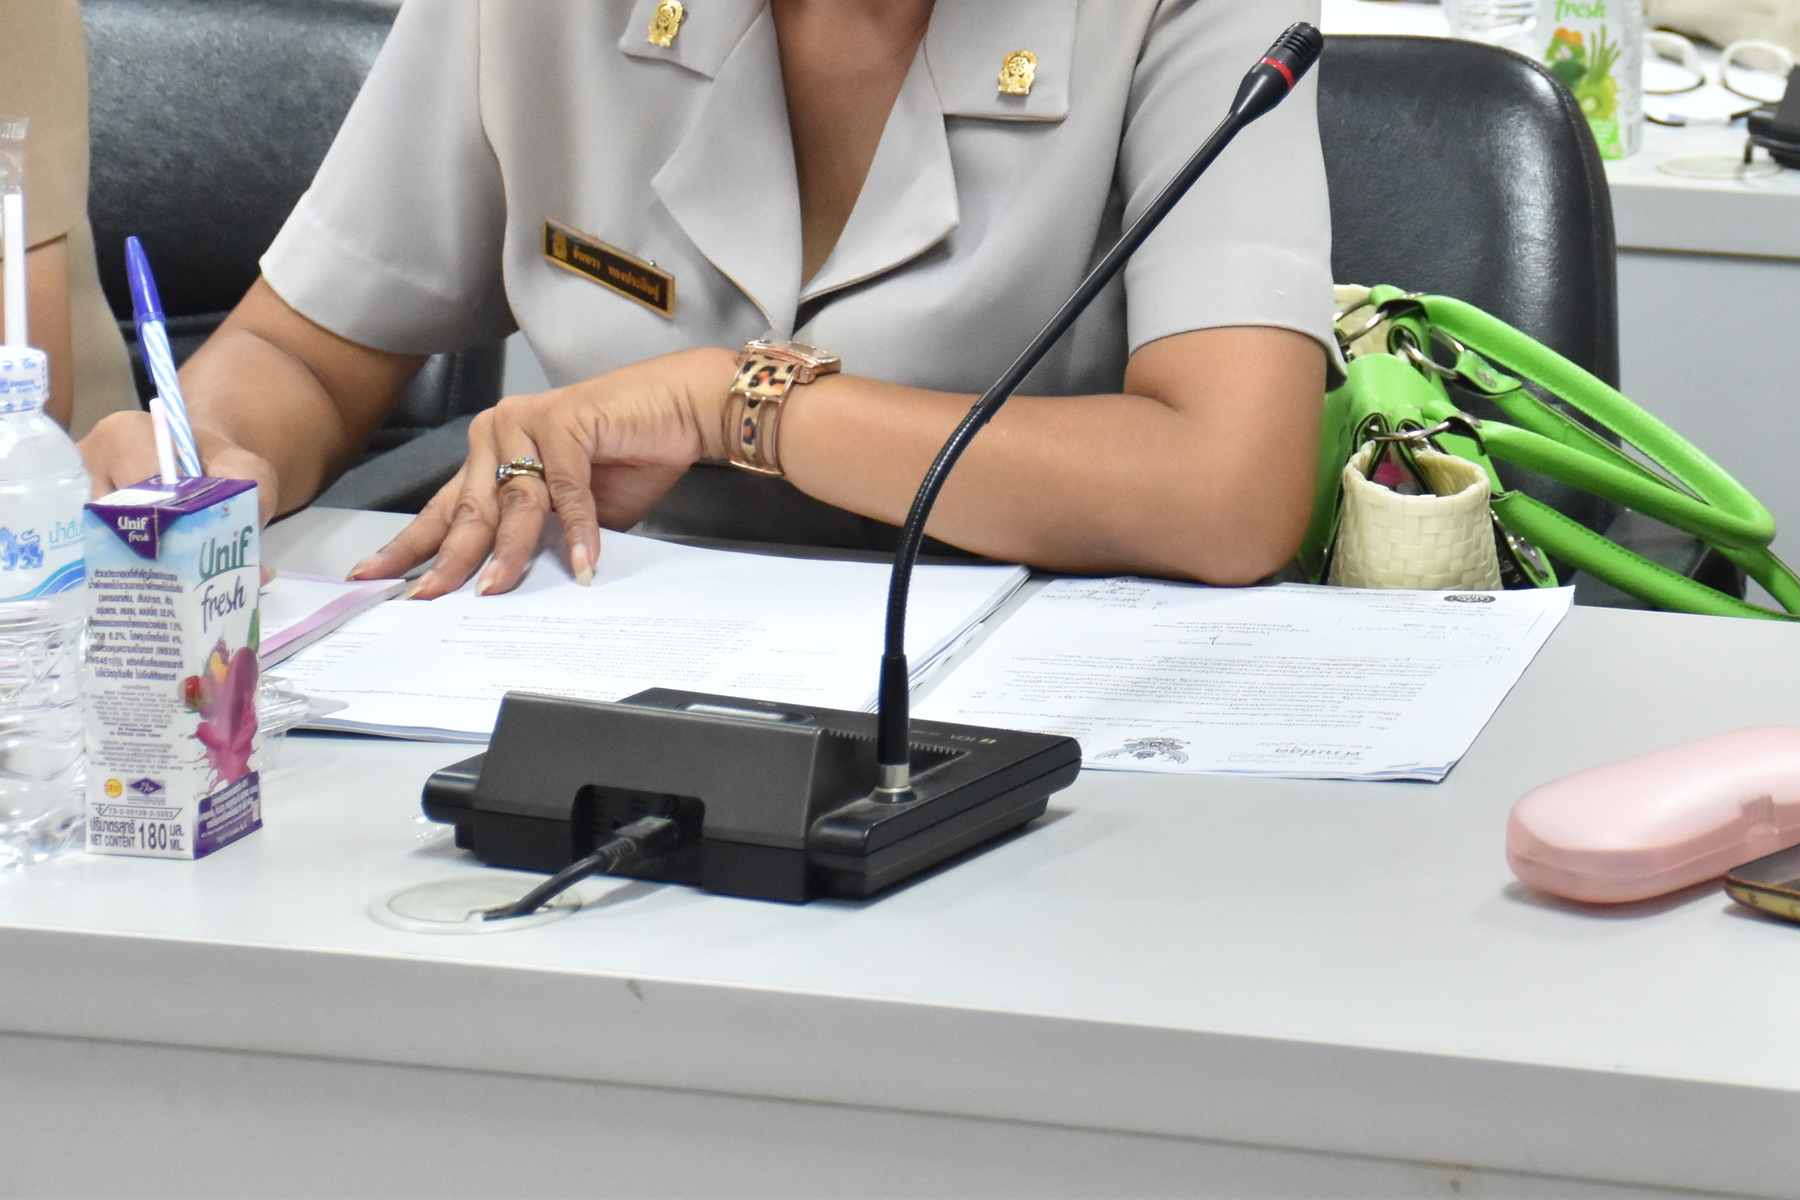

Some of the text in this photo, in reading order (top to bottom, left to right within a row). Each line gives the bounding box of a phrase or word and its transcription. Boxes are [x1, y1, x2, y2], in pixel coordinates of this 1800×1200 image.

[117, 515, 149, 531] Unif
[128, 531, 149, 543] fresh
[199, 525, 254, 581] Unif
[201, 575, 246, 635] fresh
[104, 834, 135, 849] CONTENT
[169, 839, 184, 851] ML.
[139, 822, 167, 850] 180
[169, 824, 184, 837] มล.
